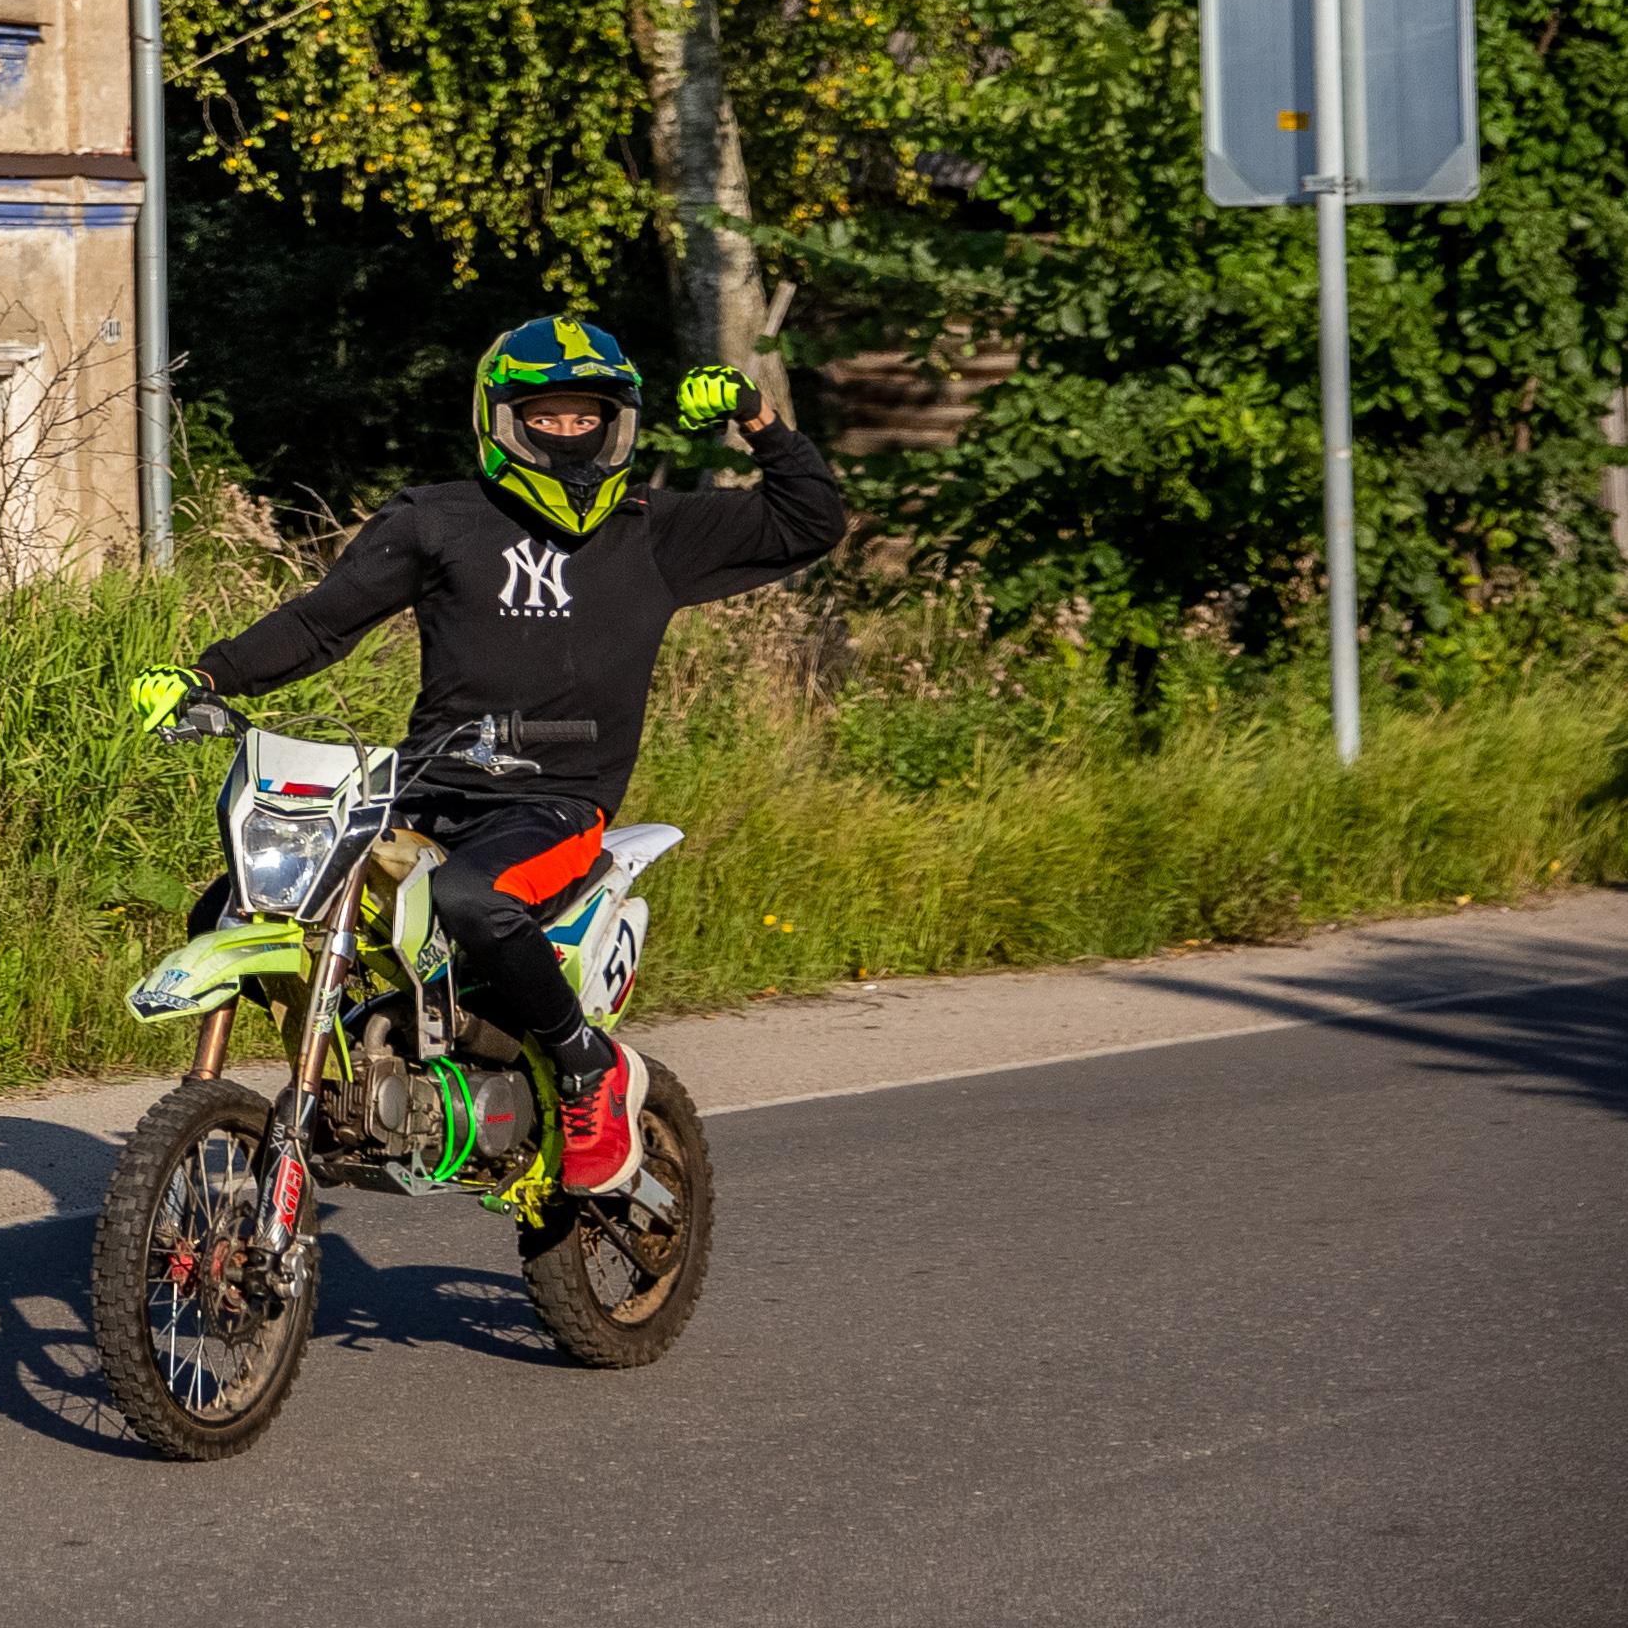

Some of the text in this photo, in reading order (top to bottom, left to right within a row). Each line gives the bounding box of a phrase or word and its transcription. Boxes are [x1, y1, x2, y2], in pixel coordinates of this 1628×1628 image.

[498, 538, 573, 608] NY
[499, 608, 571, 618] LONDON
[602, 917, 636, 1012] 57
[270, 1122, 286, 1155] MX
